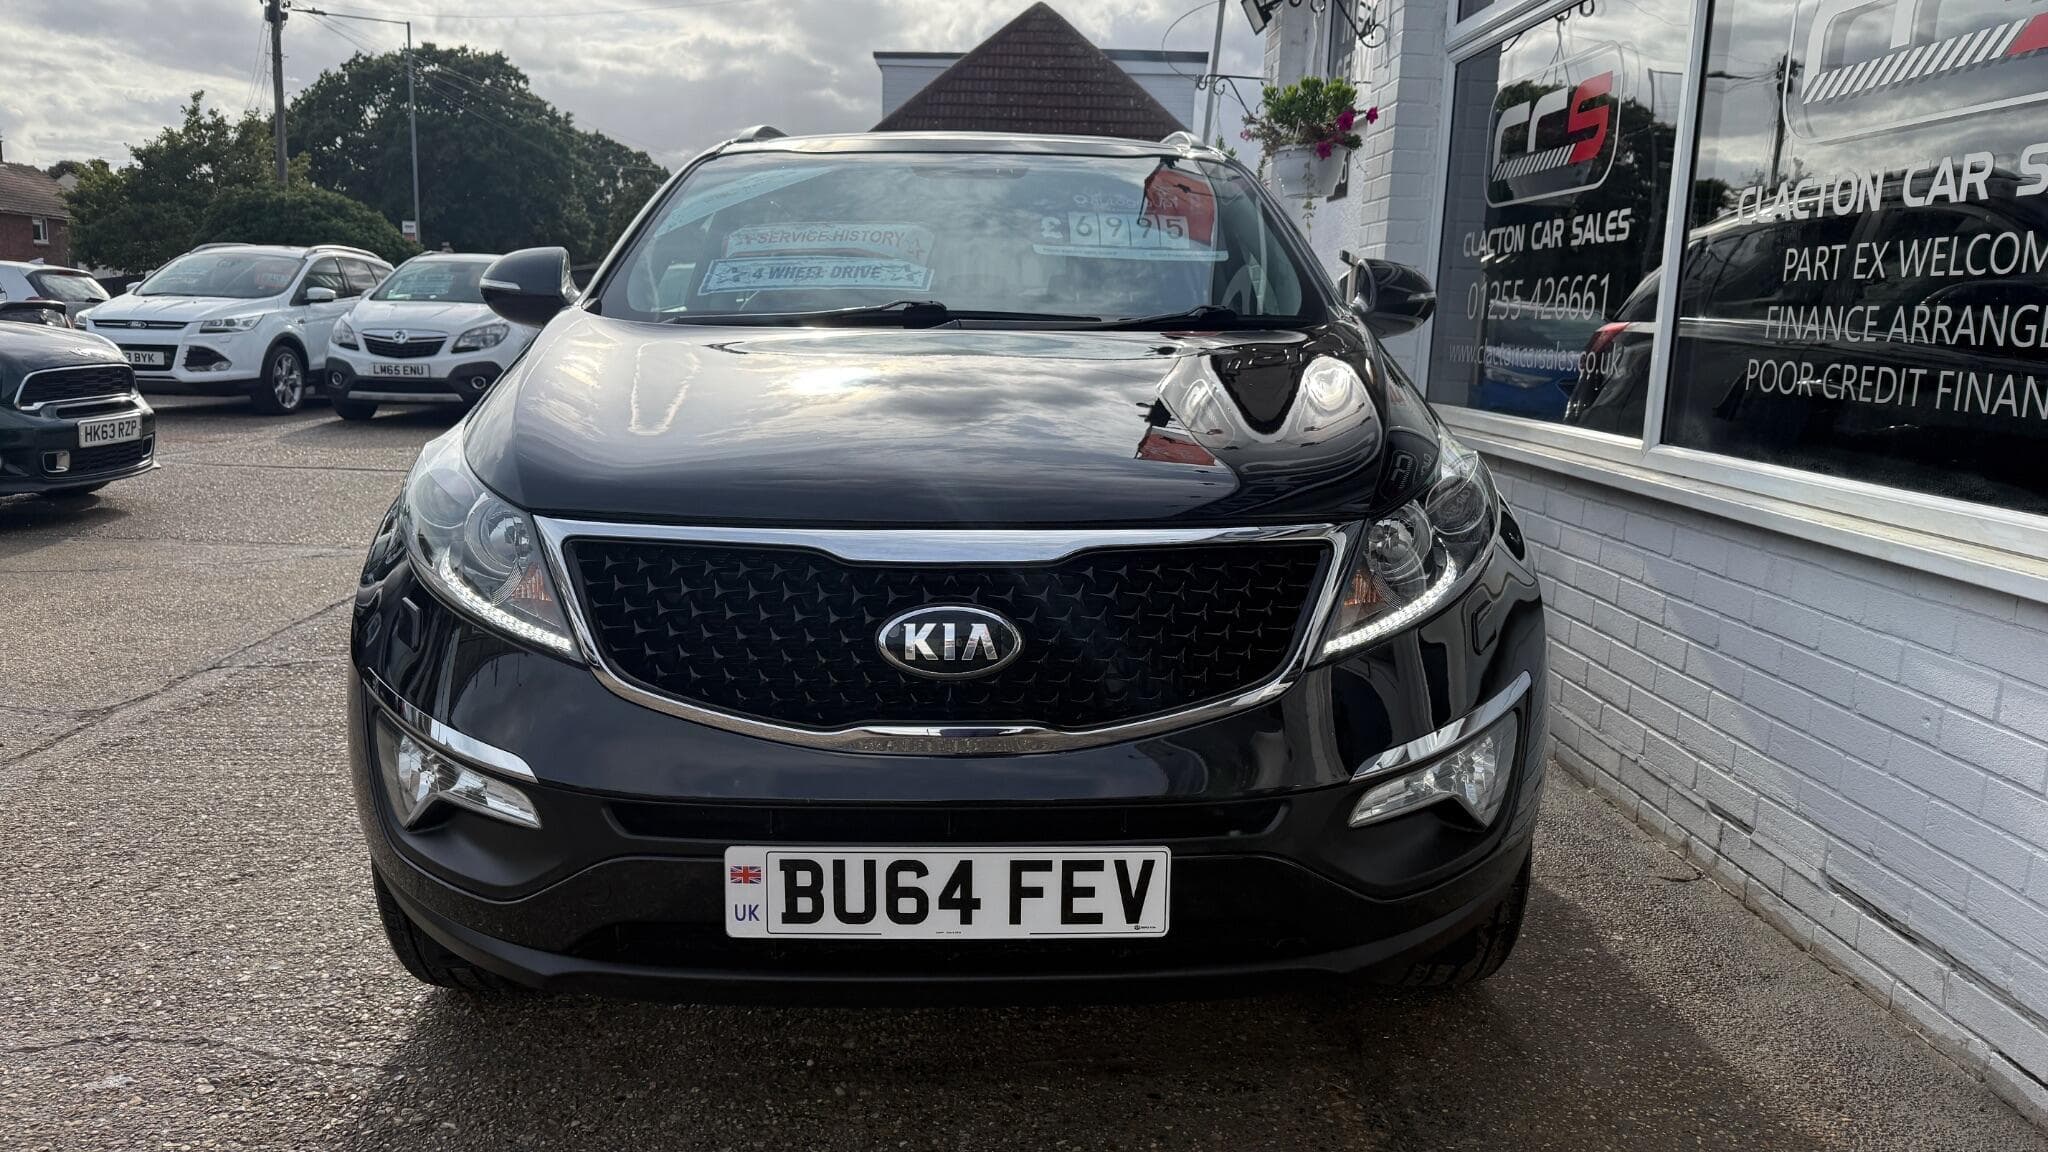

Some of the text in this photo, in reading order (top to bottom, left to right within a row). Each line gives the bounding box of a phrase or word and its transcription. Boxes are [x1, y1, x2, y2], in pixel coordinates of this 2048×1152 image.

[1737, 167, 1886, 226] CLACTON
[1902, 151, 1996, 207] CAR
[757, 230, 904, 246] SERVICE HISTORY
[1463, 208, 1632, 258] CLACTON CAR SALES
[752, 265, 881, 279] 4 WHEEL DRIVE
[1783, 244, 1847, 282] PART
[1853, 241, 1890, 280] EX
[1467, 273, 1610, 320] 01255 426661
[1765, 304, 2048, 349] FINANCE ARRANG
[373, 364, 400, 375] LM65
[1450, 338, 1624, 377] www.clactoncarsales.co.uk
[1746, 358, 1814, 397] POOR
[1822, 363, 1928, 407] CREDIT
[85, 420, 137, 442] HK63 RZP
[904, 623, 998, 660] KIA
[779, 859, 1156, 925] BU64 FEV
[734, 903, 760, 922] UK
